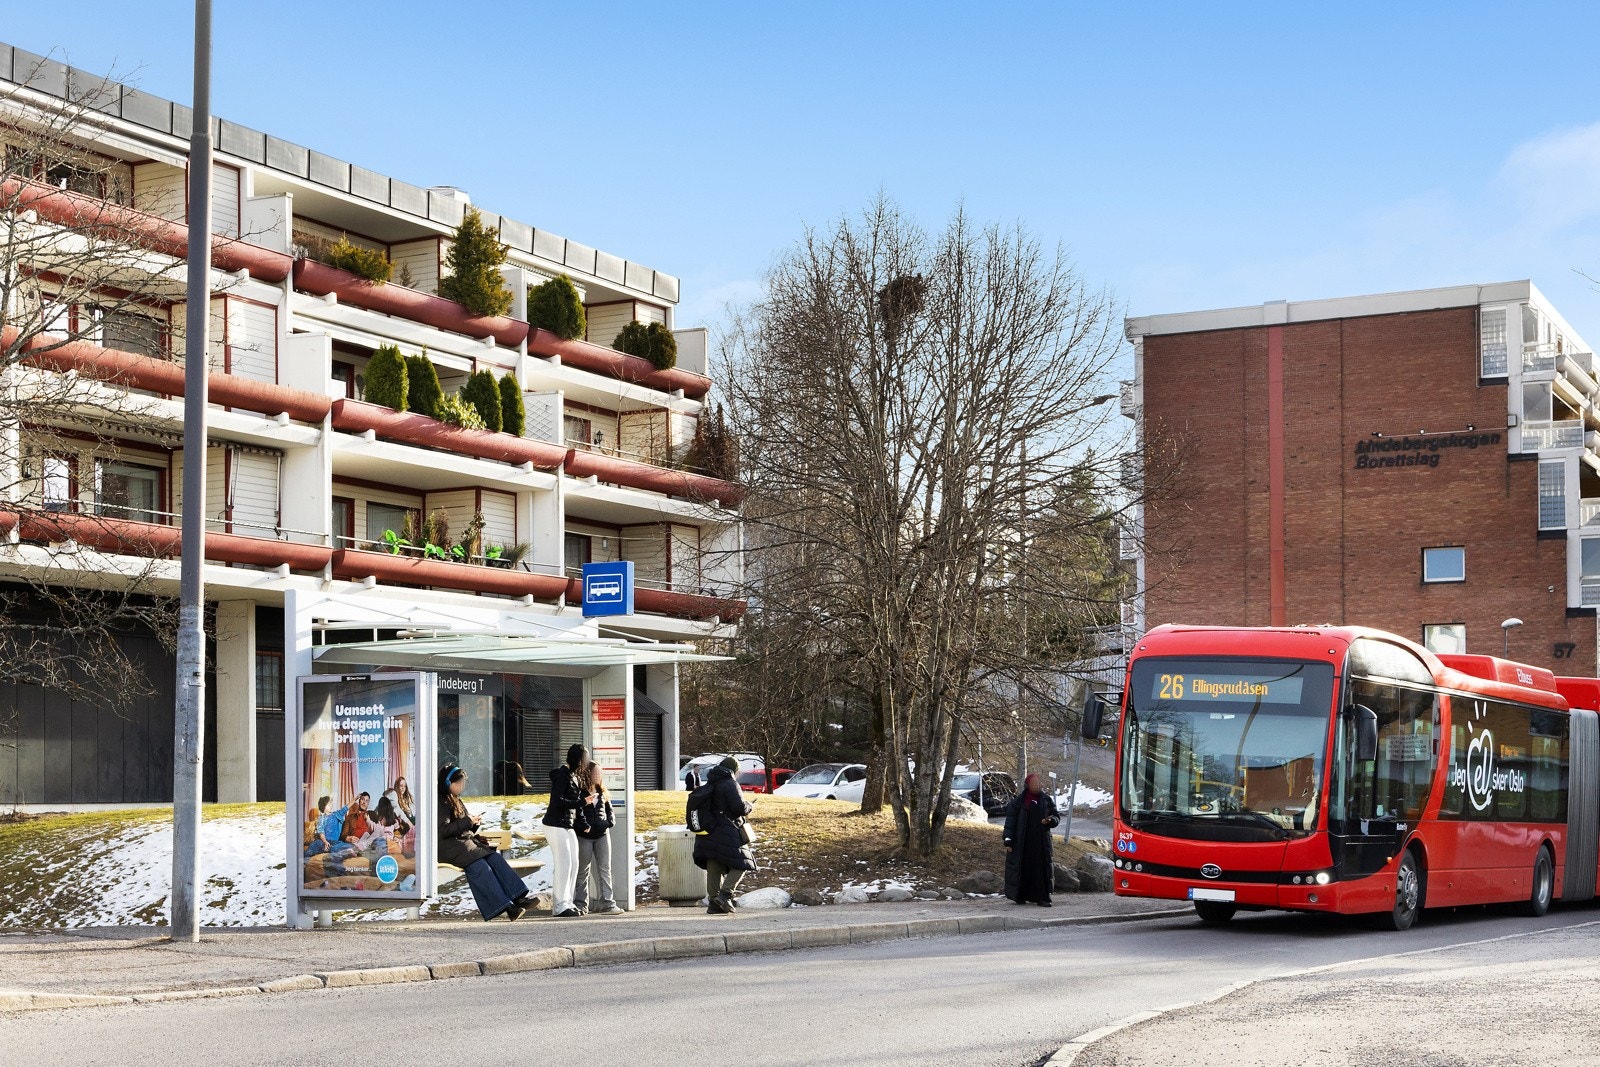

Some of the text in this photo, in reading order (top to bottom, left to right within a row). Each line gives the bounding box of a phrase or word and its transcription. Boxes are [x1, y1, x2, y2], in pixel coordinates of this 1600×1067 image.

[1355, 453, 1441, 470] Borettslag
[1553, 642, 1576, 658] 57
[478, 678, 485, 691] T
[1160, 674, 1268, 699] 26 Ellingsrudåsen
[335, 703, 385, 716] Uansett
[318, 716, 403, 732] hva dagen din
[334, 730, 385, 746] bringer.
[1451, 762, 1466, 793] Jeg
[1492, 766, 1508, 791] sker
[1509, 769, 1524, 792] Oslo
[1119, 832, 1133, 840] 8439
[380, 865, 395, 874] Wolt
[1202, 866, 1219, 875] BYD
